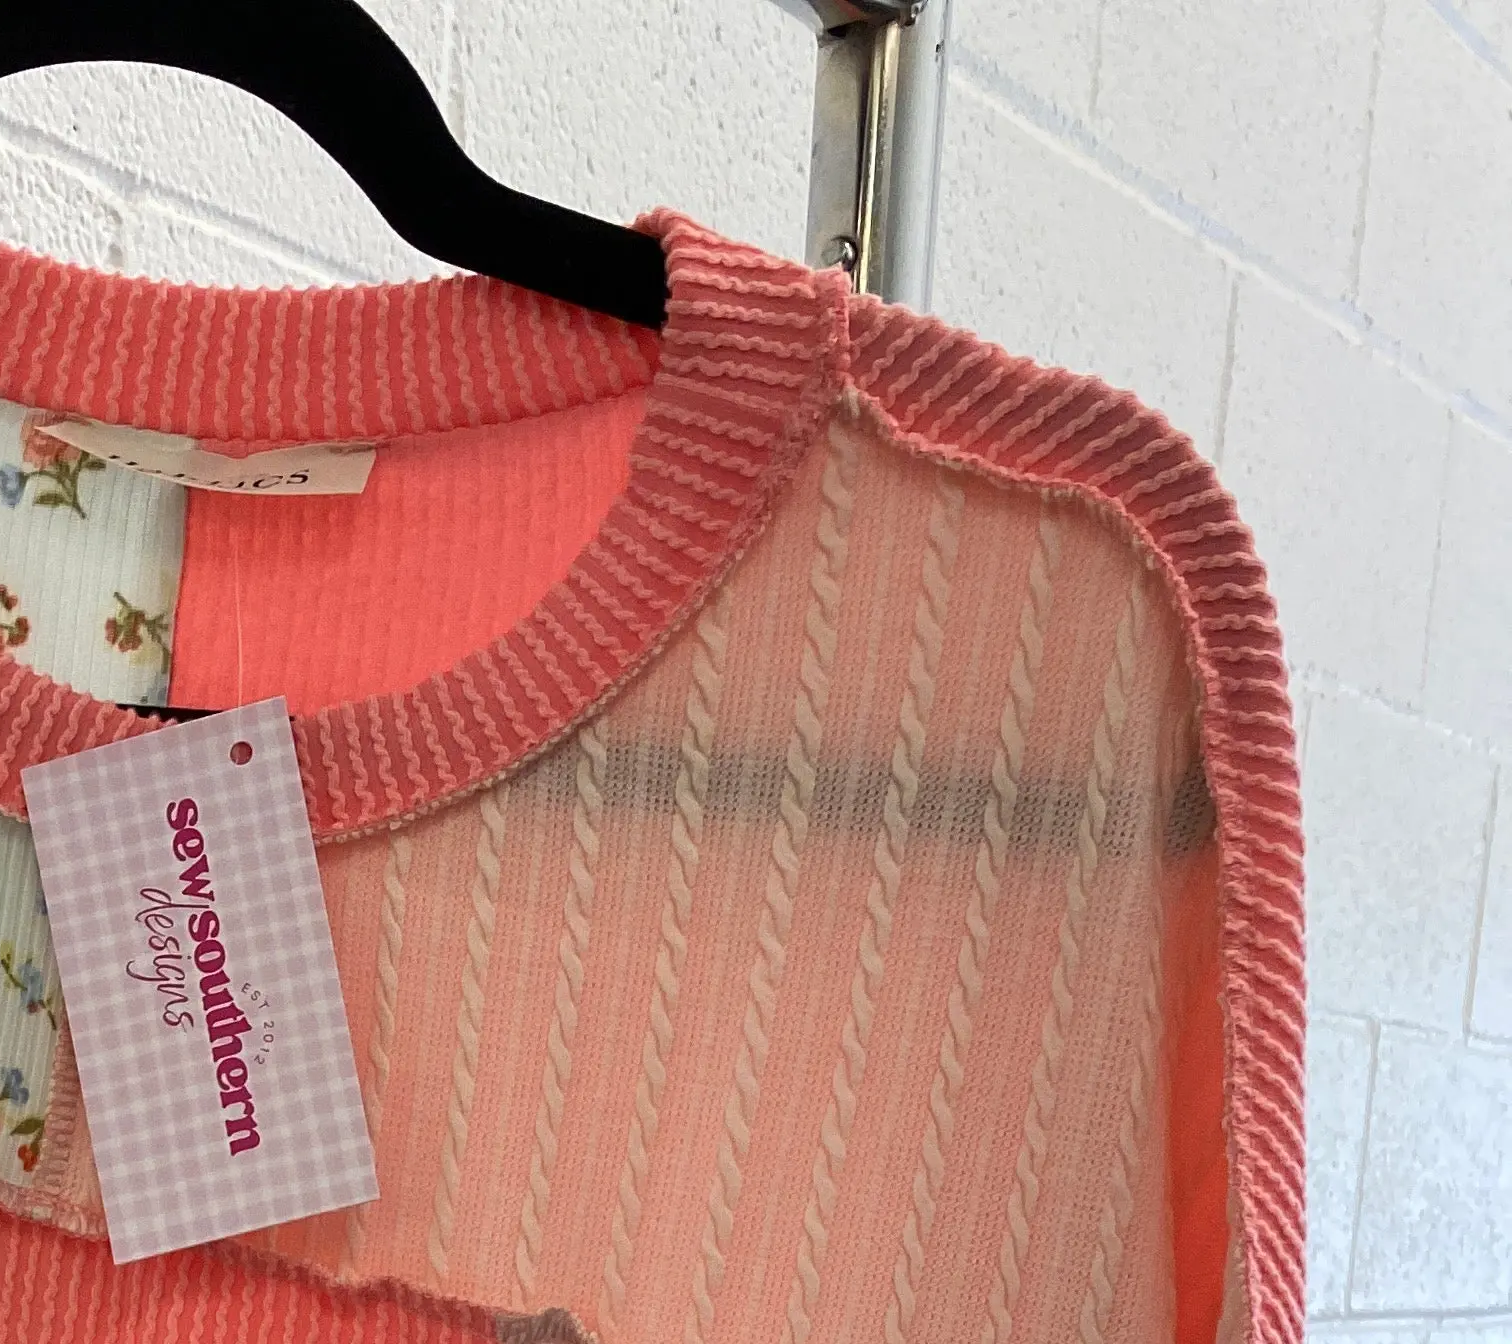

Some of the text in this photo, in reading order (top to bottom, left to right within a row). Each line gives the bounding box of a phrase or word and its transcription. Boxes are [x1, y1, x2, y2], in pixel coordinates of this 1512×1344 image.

[125, 888, 210, 1029] designs
[167, 798, 261, 1156] sew southern
[241, 982, 275, 1065] EST 2012
